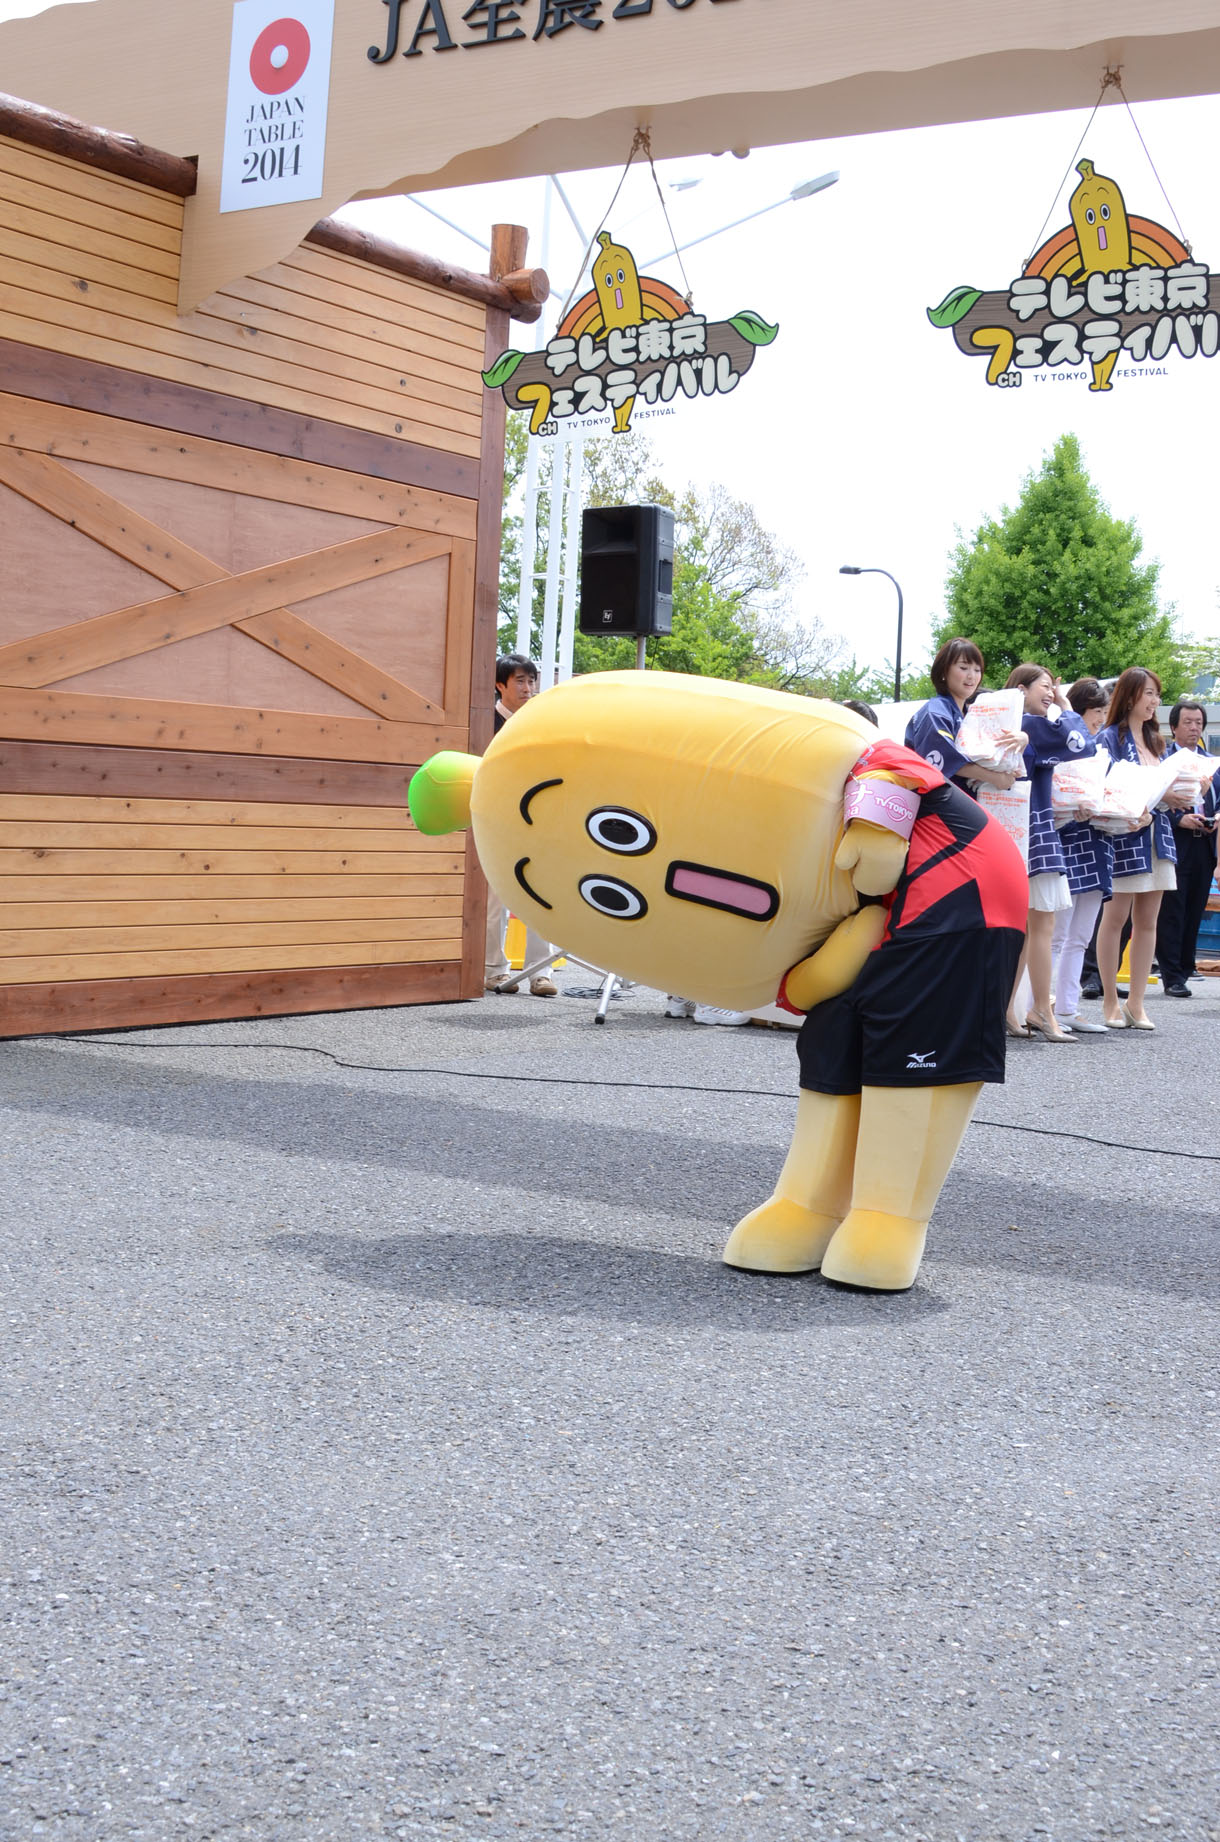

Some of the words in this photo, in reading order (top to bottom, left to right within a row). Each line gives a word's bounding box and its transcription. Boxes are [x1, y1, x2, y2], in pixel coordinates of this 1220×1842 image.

[246, 96, 305, 124] JAPAN
[244, 119, 304, 147] TABLE
[241, 144, 303, 184] 2014
[1009, 263, 1209, 322] テレビ東京
[546, 314, 706, 376] テレビ東京
[1033, 374, 1047, 382] TV
[1052, 372, 1088, 381] TOKYO
[1116, 367, 1169, 378] FESTIVAL
[580, 417, 611, 427] TOKYO
[634, 408, 677, 419] FESTIVAL
